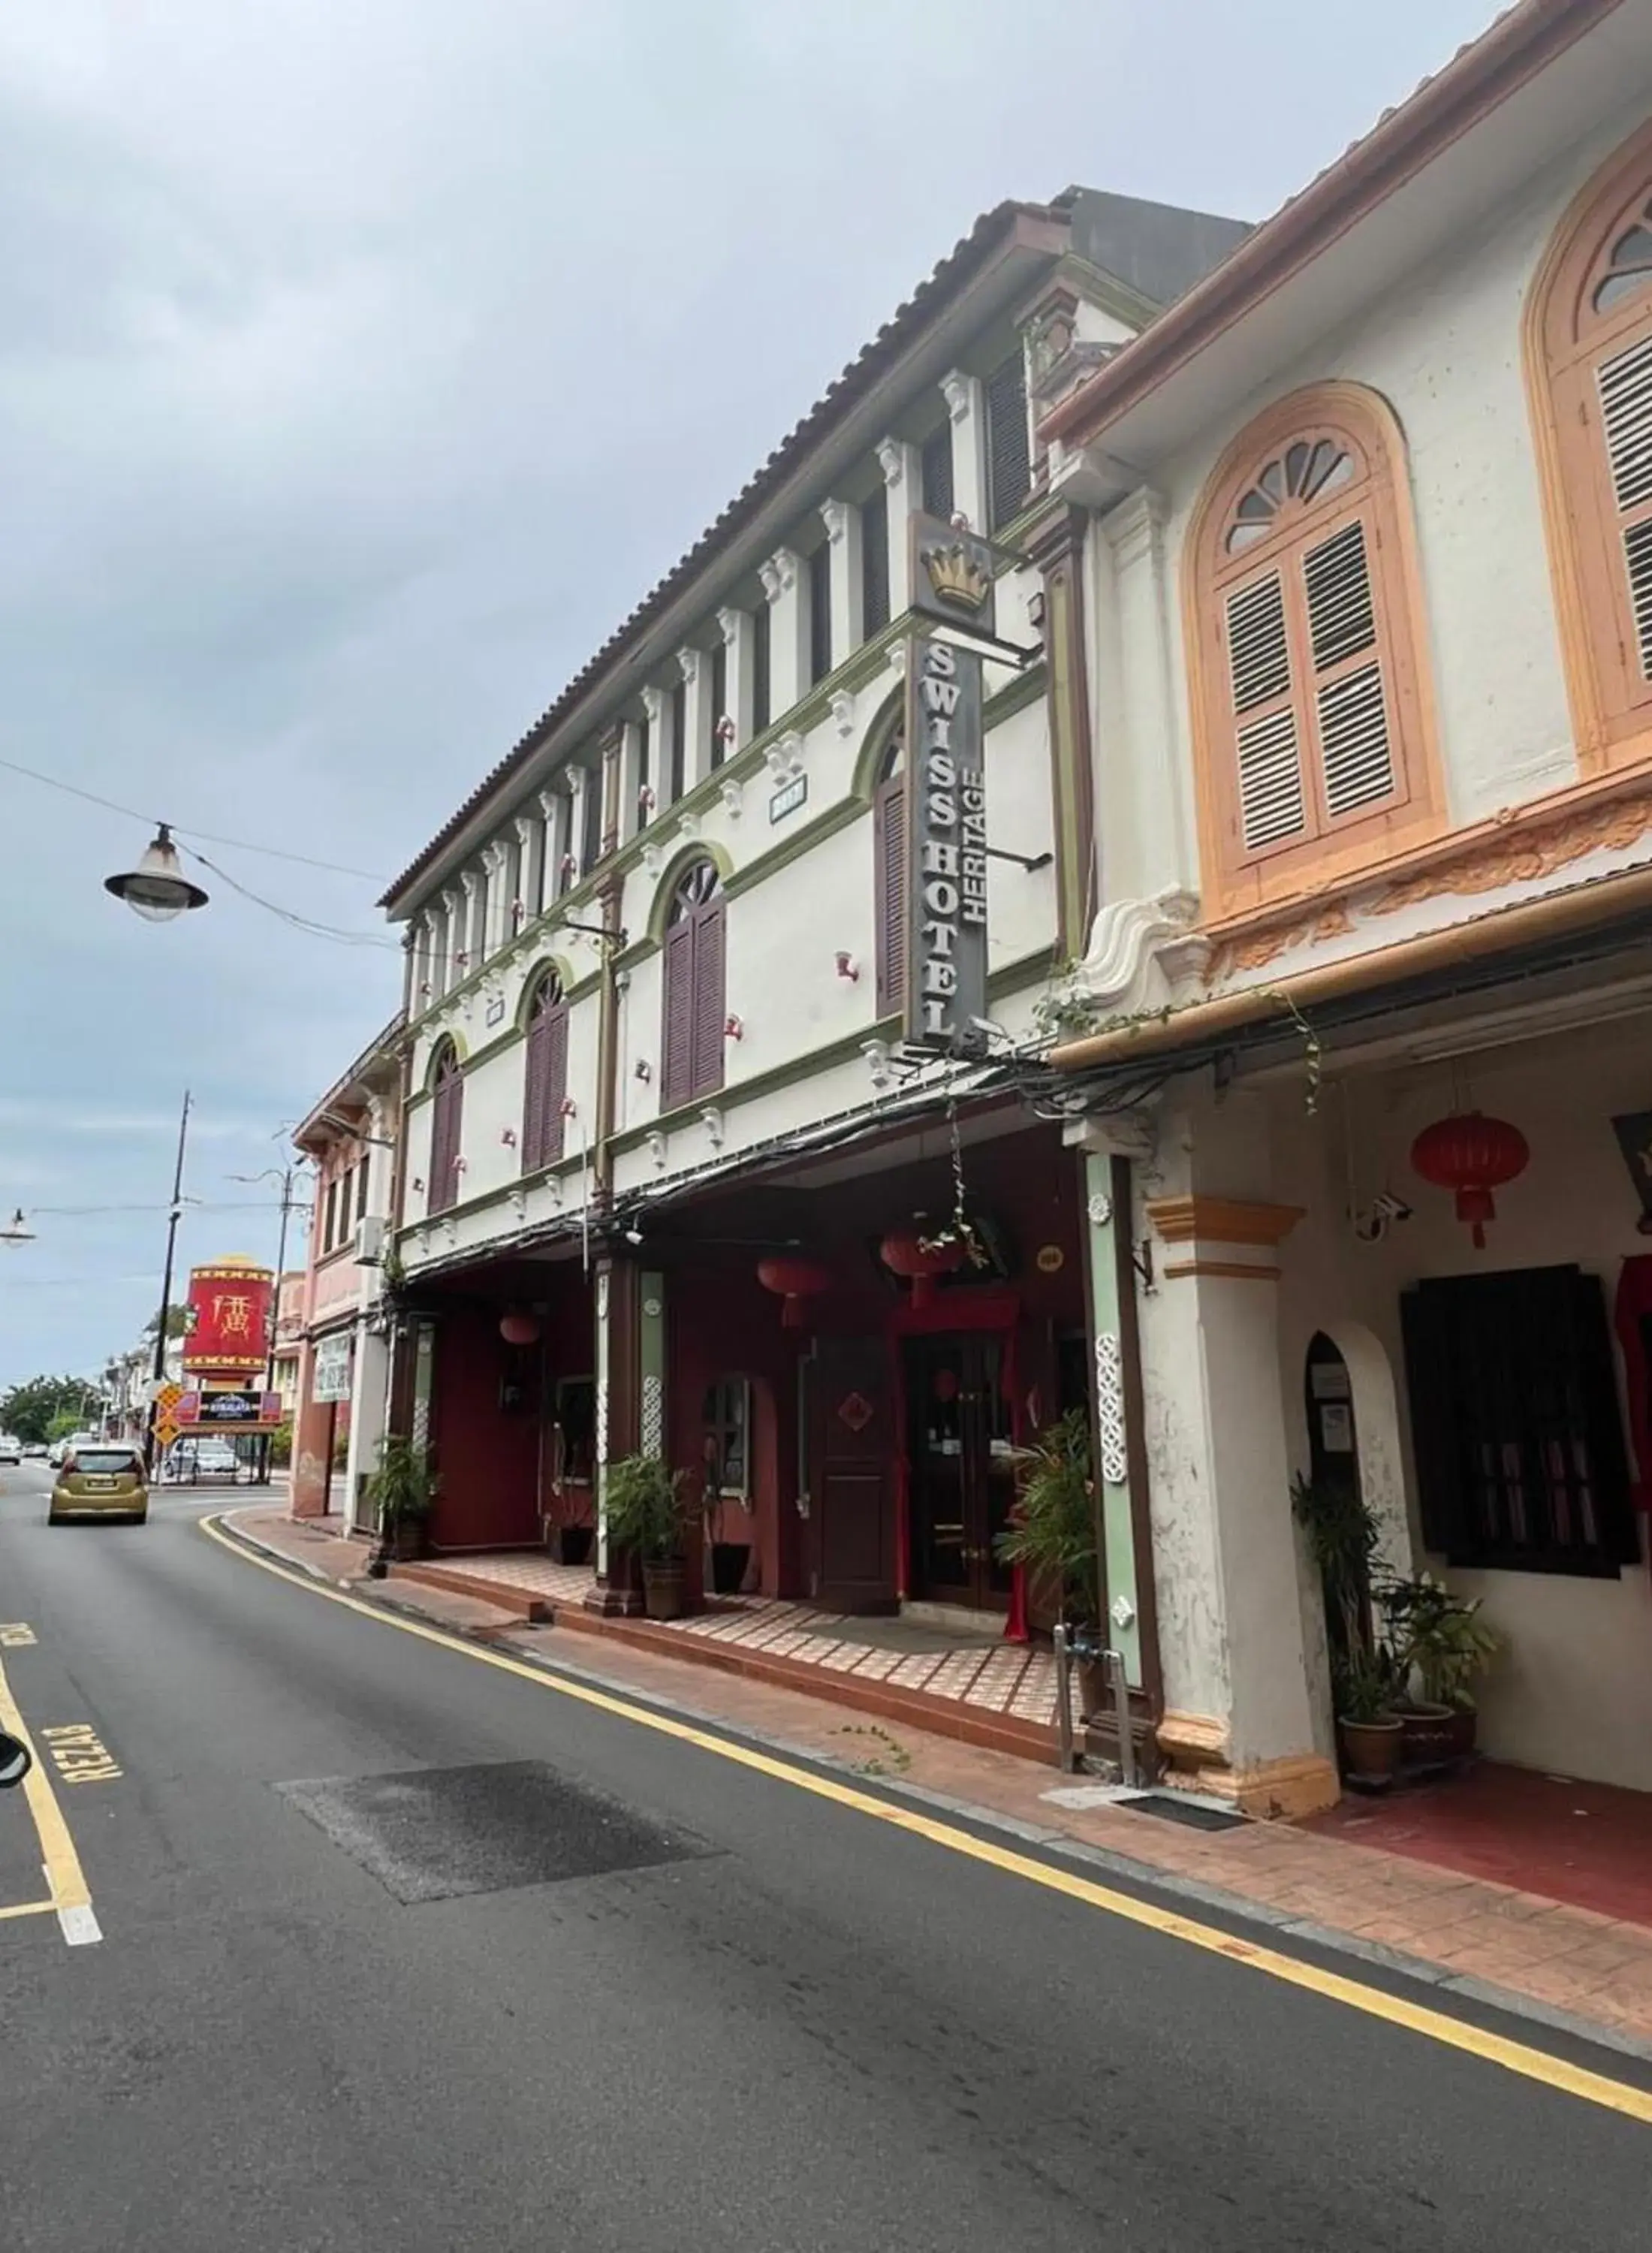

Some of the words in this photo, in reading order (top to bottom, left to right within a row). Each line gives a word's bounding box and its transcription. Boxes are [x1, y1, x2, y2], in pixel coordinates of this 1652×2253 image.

[920, 643, 960, 826] SWISS
[962, 767, 986, 923] HERITAGE
[923, 840, 960, 1035] HOTEL
